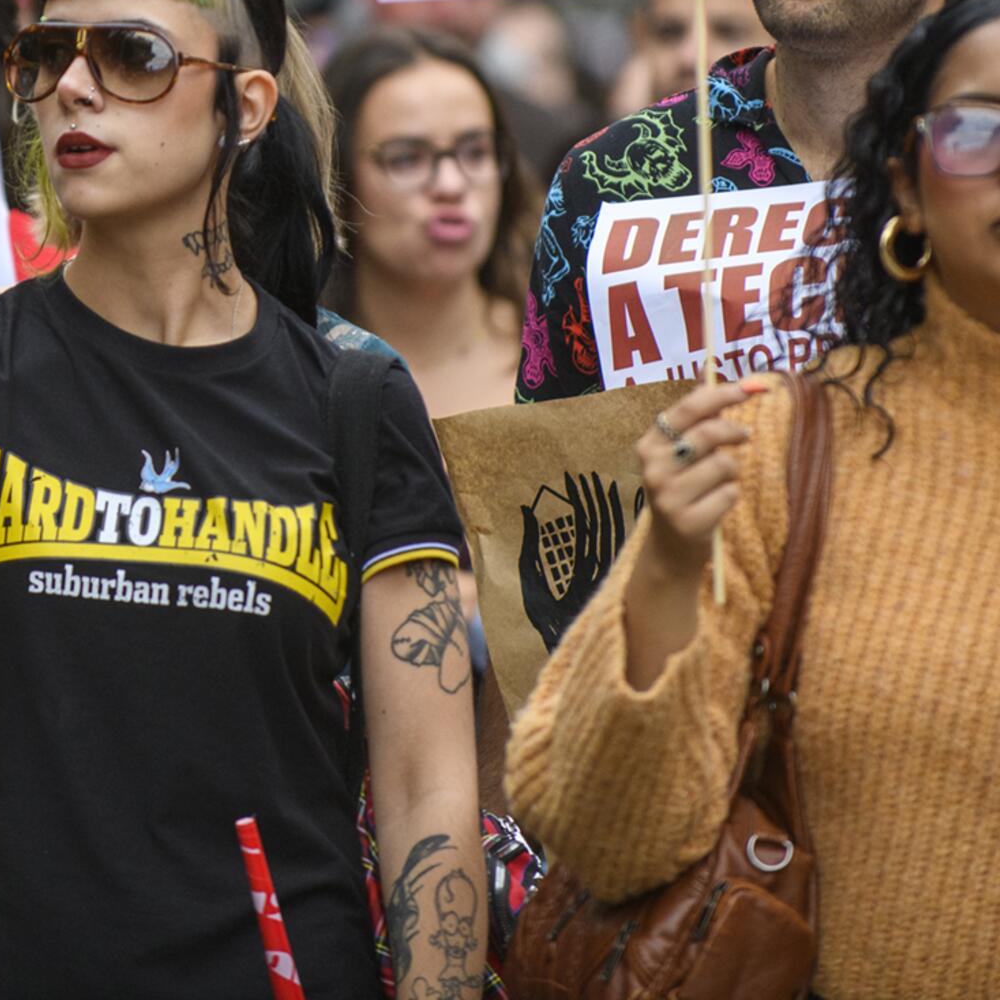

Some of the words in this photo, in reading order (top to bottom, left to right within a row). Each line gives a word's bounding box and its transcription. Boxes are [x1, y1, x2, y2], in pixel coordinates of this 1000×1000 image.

[607, 281, 663, 372] A
[28, 564, 170, 607] suburban
[177, 576, 273, 617] rebels
